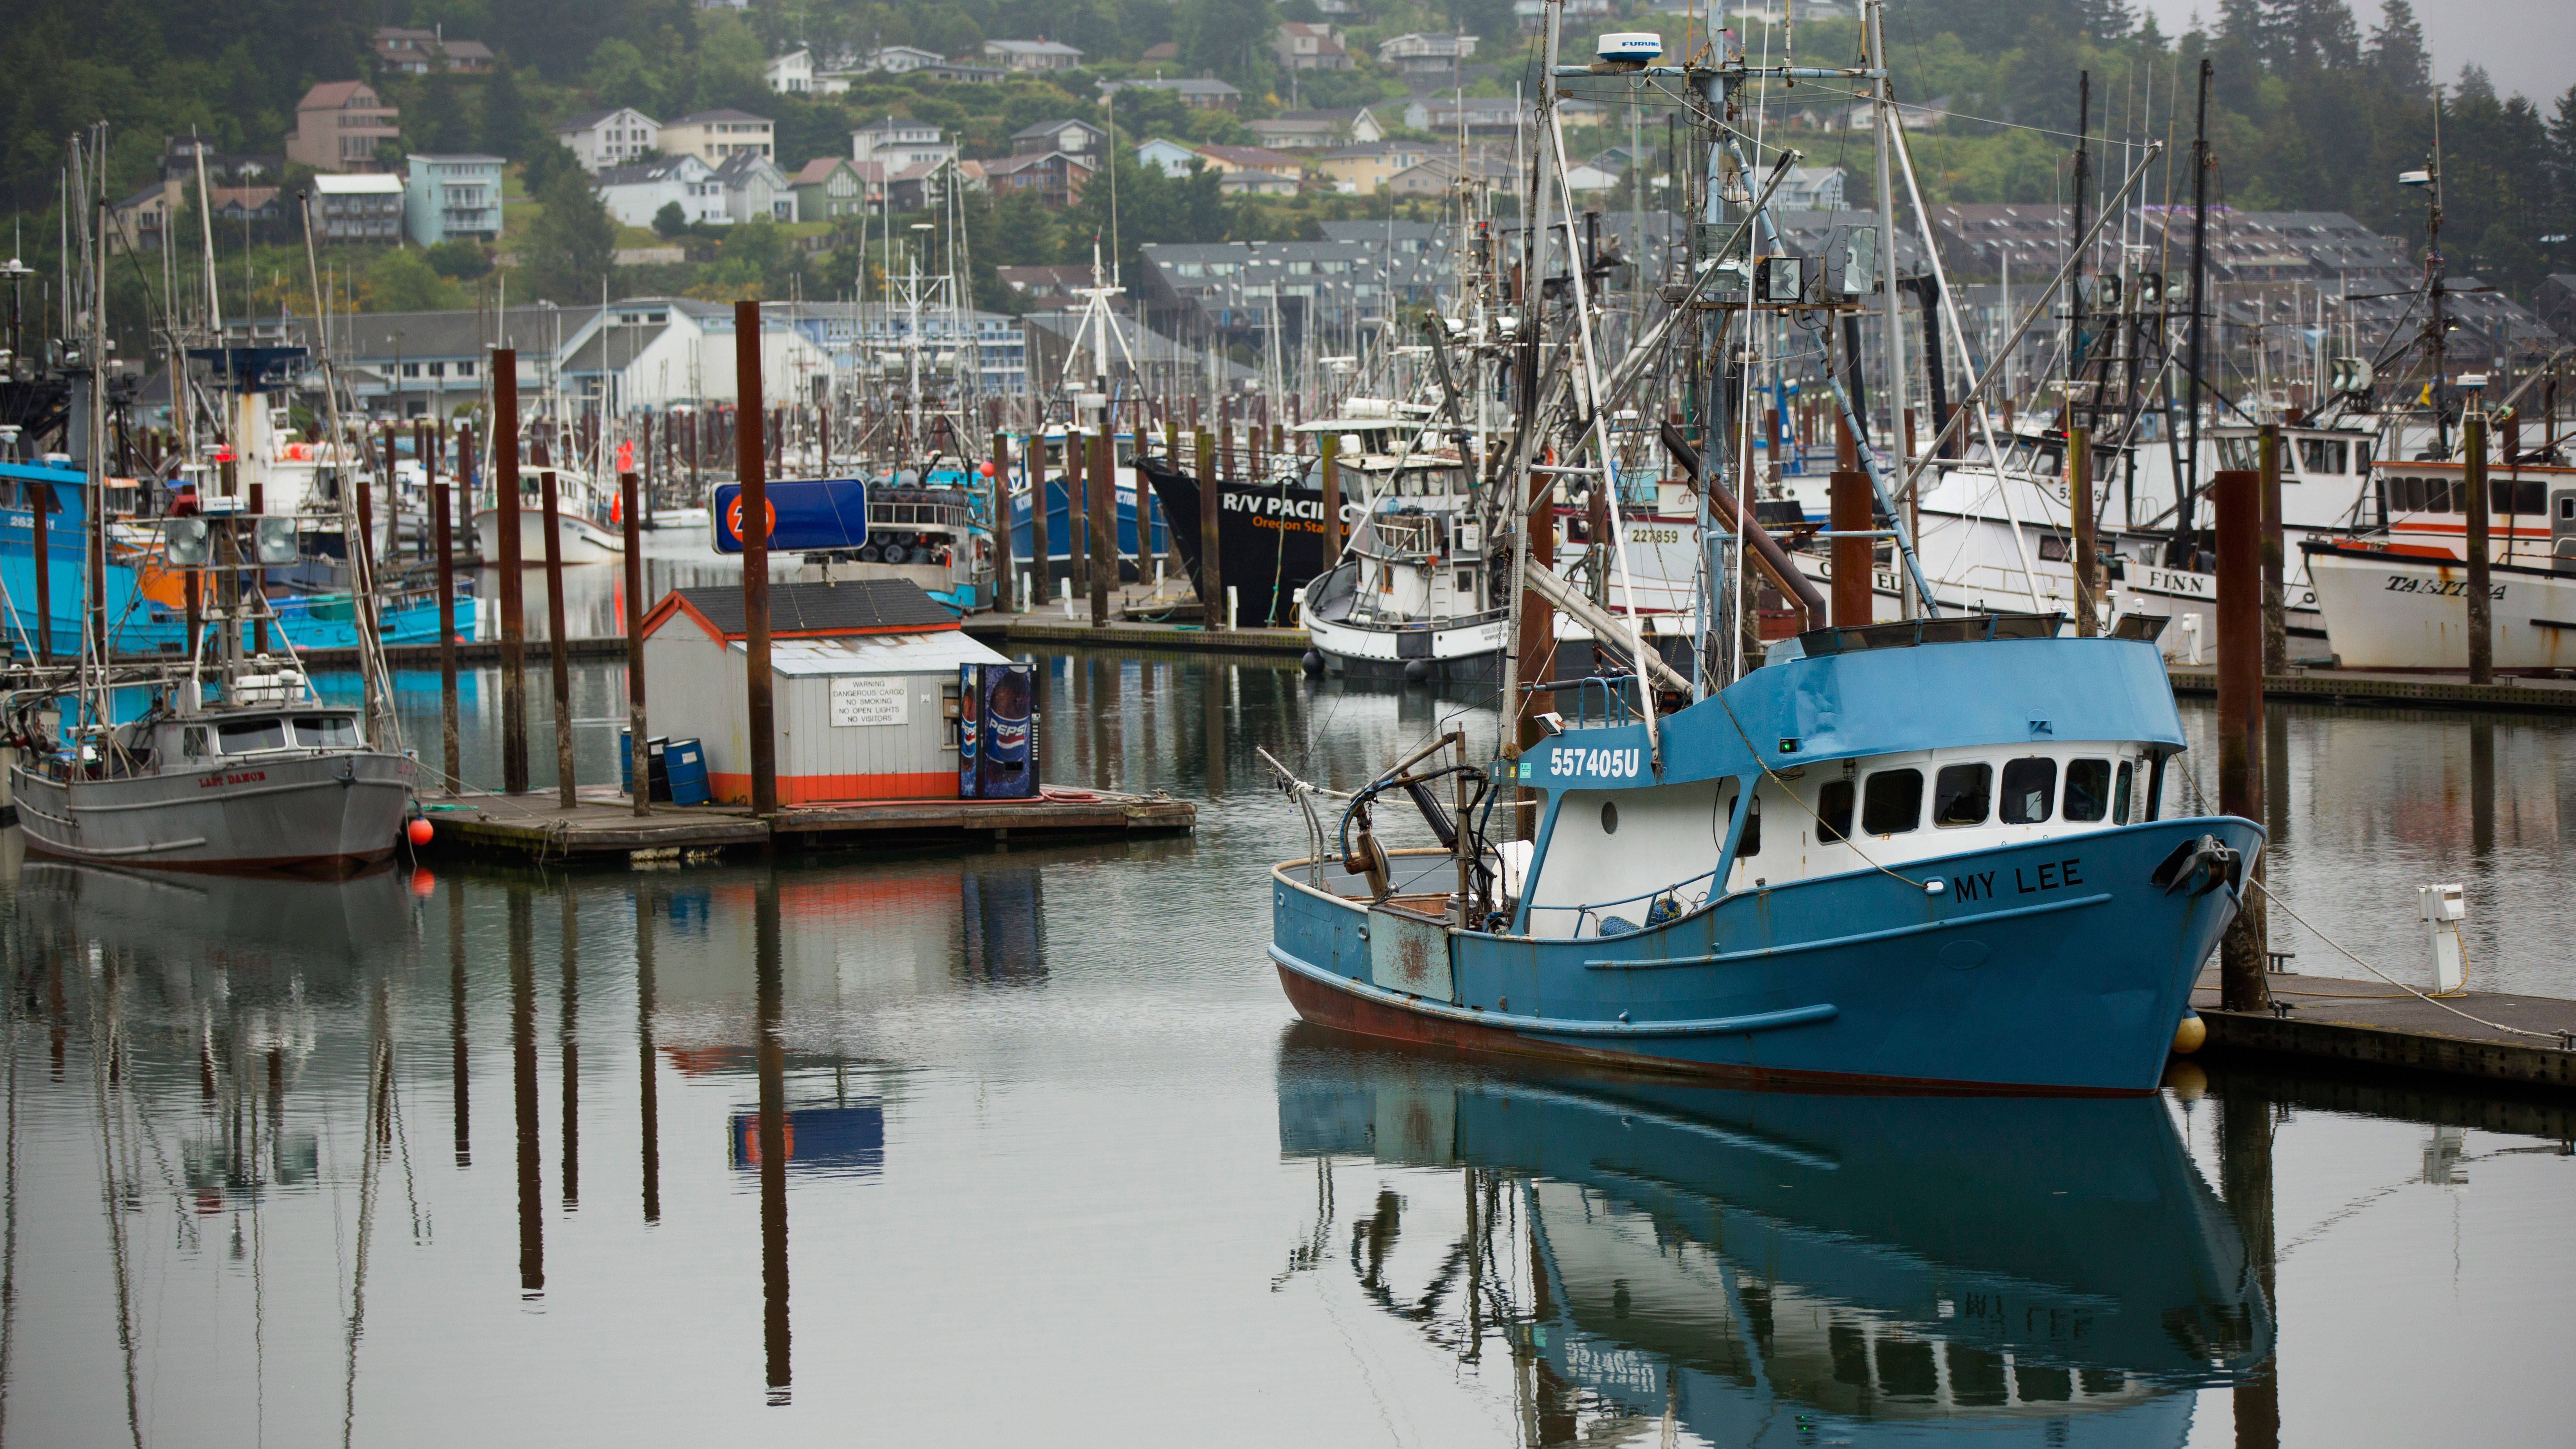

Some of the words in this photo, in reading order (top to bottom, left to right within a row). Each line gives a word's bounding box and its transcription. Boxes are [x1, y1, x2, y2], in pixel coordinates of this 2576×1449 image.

[1223, 493, 1263, 513] R/V
[1633, 530, 1678, 543] 227859
[2149, 571, 2204, 593] FINN
[989, 717, 1027, 737] PEPSI
[1551, 748, 1639, 778] 557405U
[199, 776, 224, 788] LAST
[1953, 871, 1996, 904] MY
[2015, 857, 2083, 894] LEE
